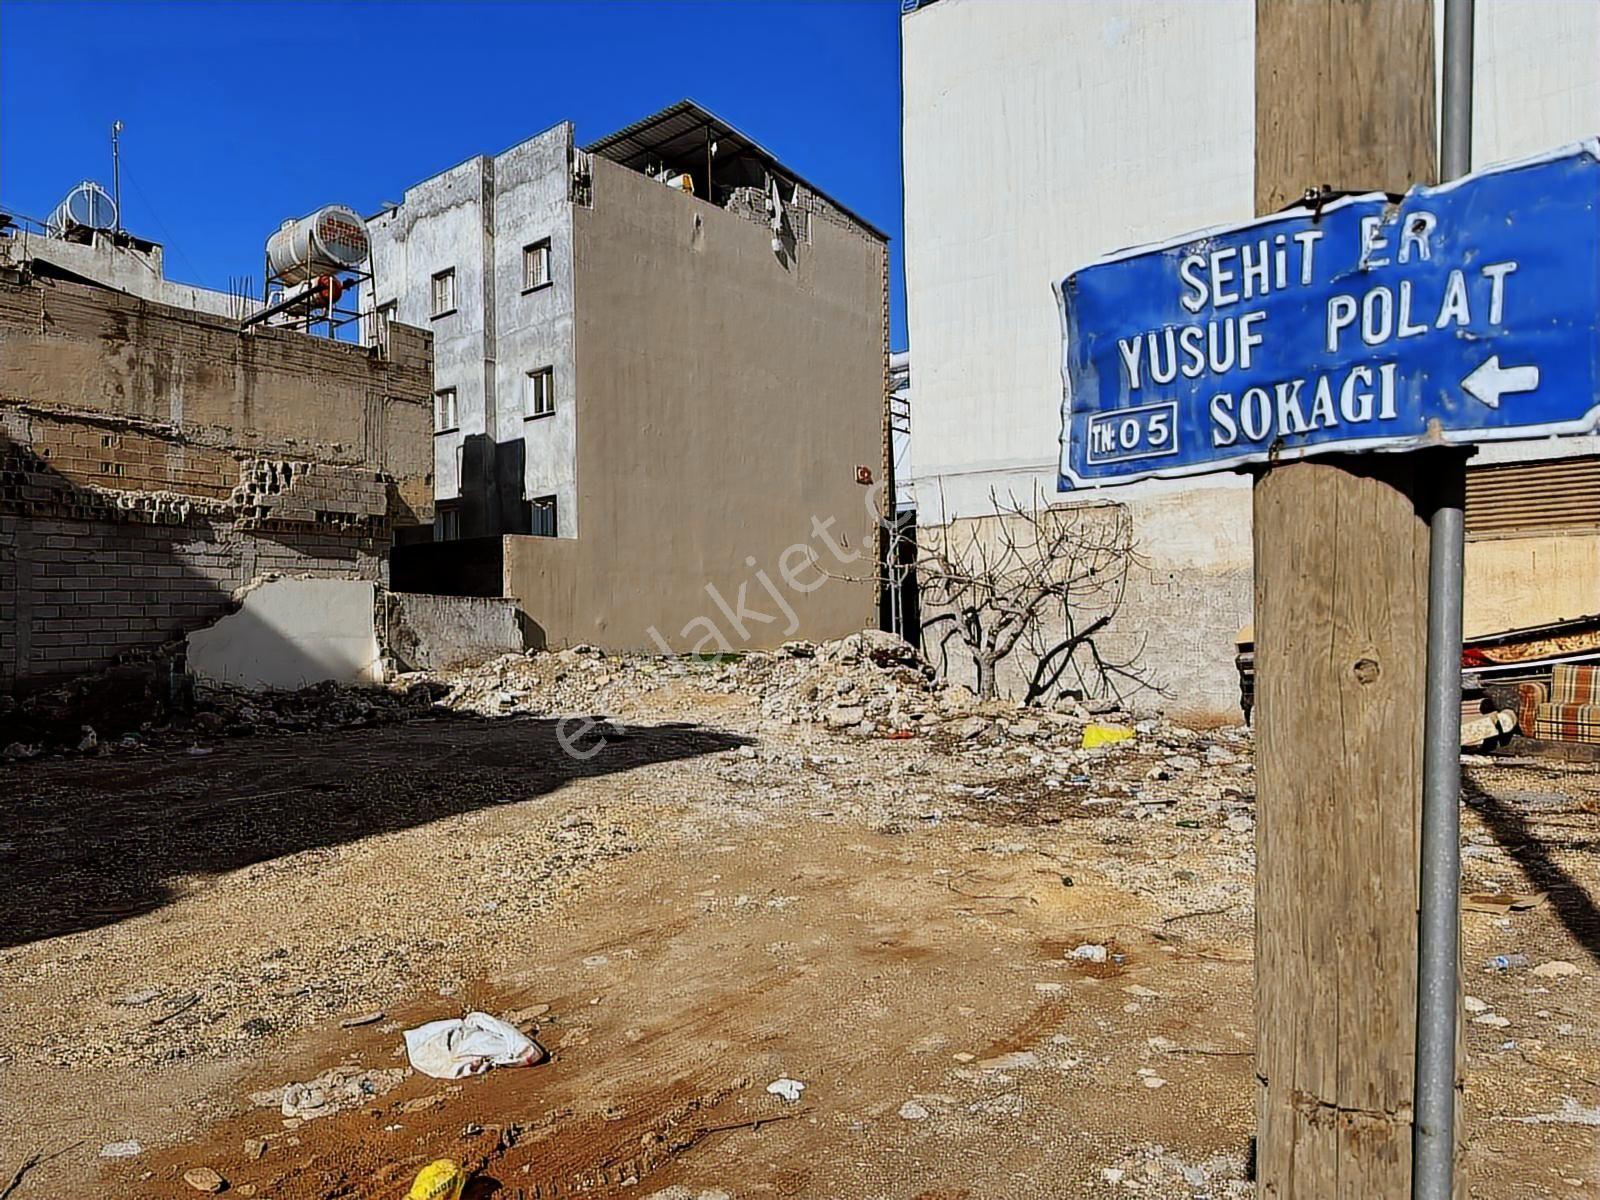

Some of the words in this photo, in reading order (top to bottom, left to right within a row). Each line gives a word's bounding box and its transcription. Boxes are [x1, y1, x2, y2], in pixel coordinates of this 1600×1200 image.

[1359, 211, 1438, 269] ER
[1118, 310, 1266, 389] YUSUF
[1326, 261, 1518, 353] POLAT
